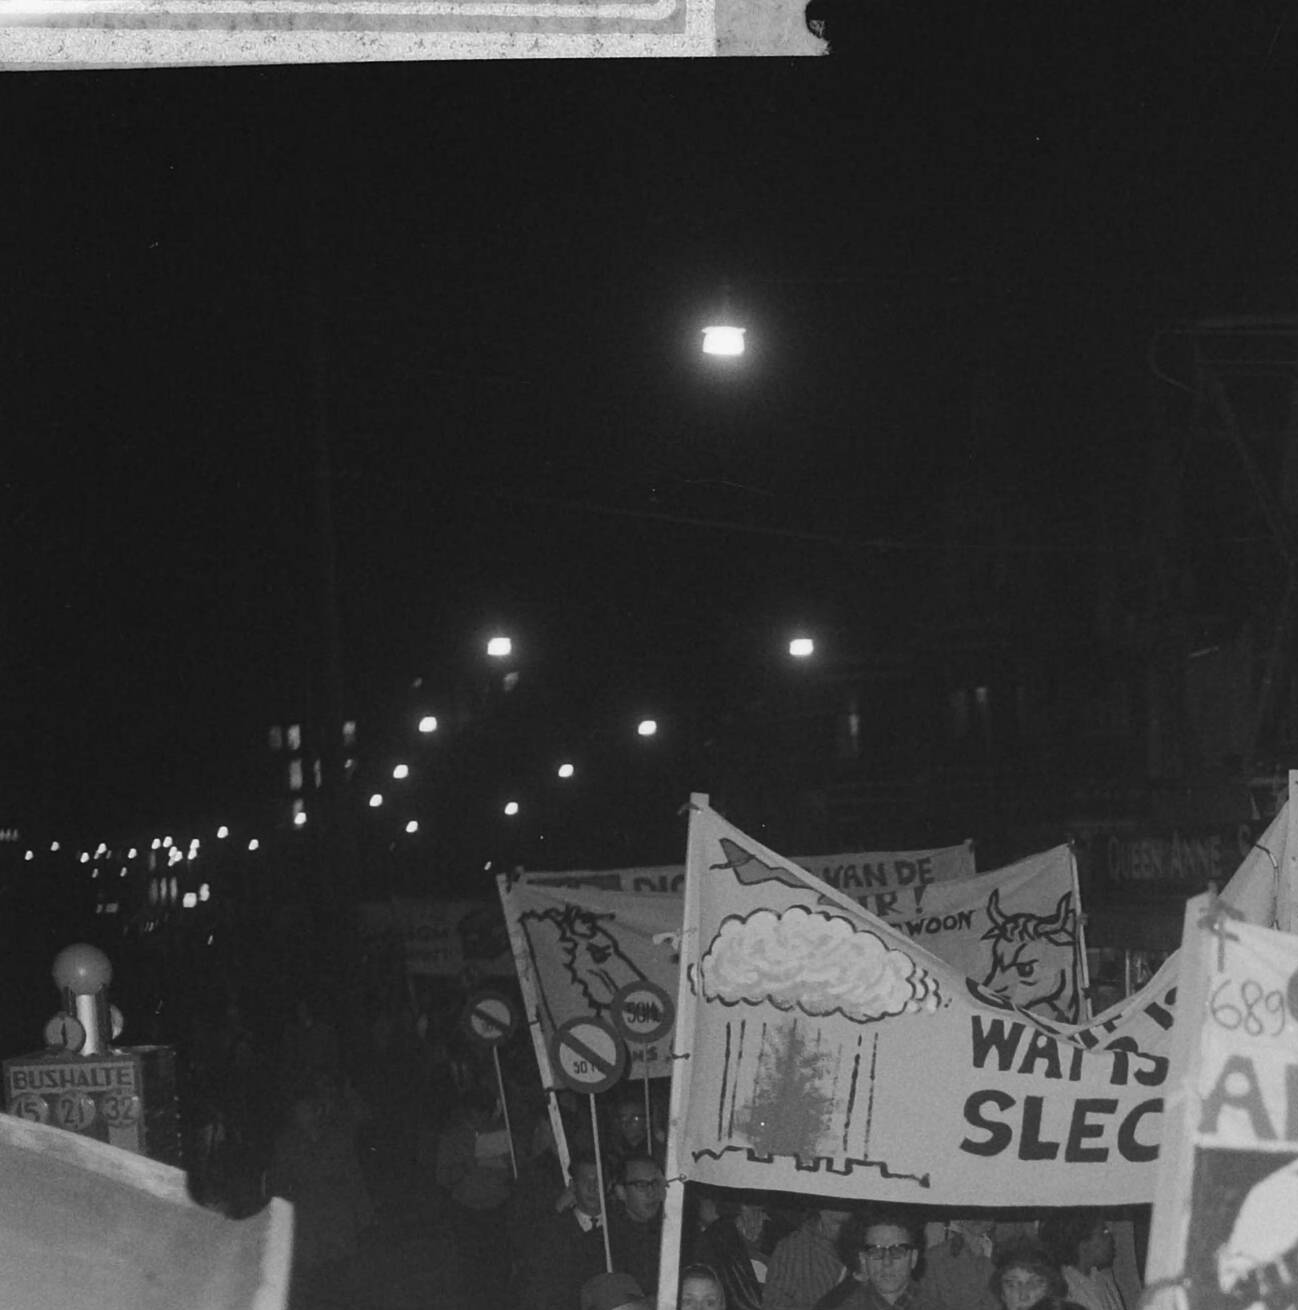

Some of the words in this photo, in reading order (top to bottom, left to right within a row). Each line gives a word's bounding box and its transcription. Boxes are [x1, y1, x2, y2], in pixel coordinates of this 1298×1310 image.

[823, 863, 886, 889] VAN
[894, 857, 934, 886] DE
[1211, 979, 1286, 1037] 689
[13, 1066, 133, 1090] BUSHALTE
[16, 1101, 41, 1122] 15
[60, 1099, 85, 1125] 21
[104, 1096, 138, 1121] 32
